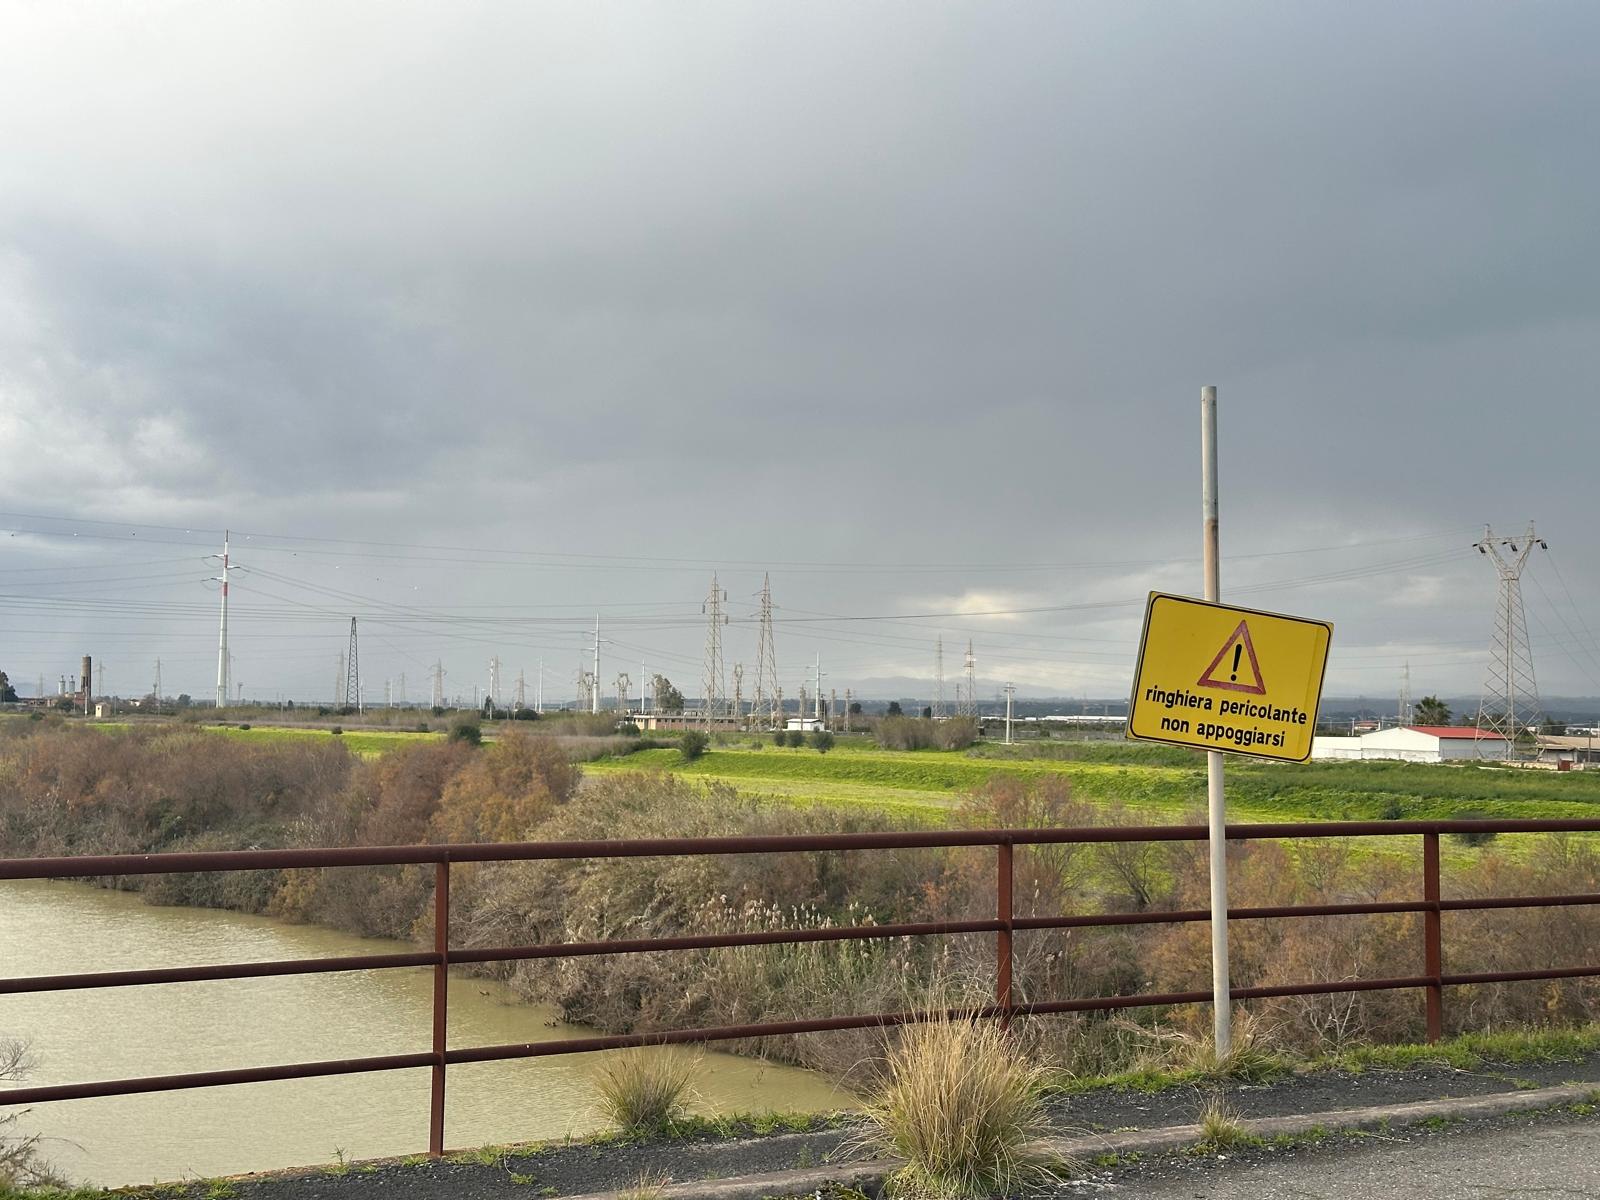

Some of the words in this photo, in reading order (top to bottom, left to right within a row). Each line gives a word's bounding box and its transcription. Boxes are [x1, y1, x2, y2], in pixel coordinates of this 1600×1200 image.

[1145, 685, 1213, 710] ringhiera
[1219, 699, 1307, 725] pericolante
[1161, 717, 1190, 733] non
[1197, 722, 1285, 747] appoggiarsi
